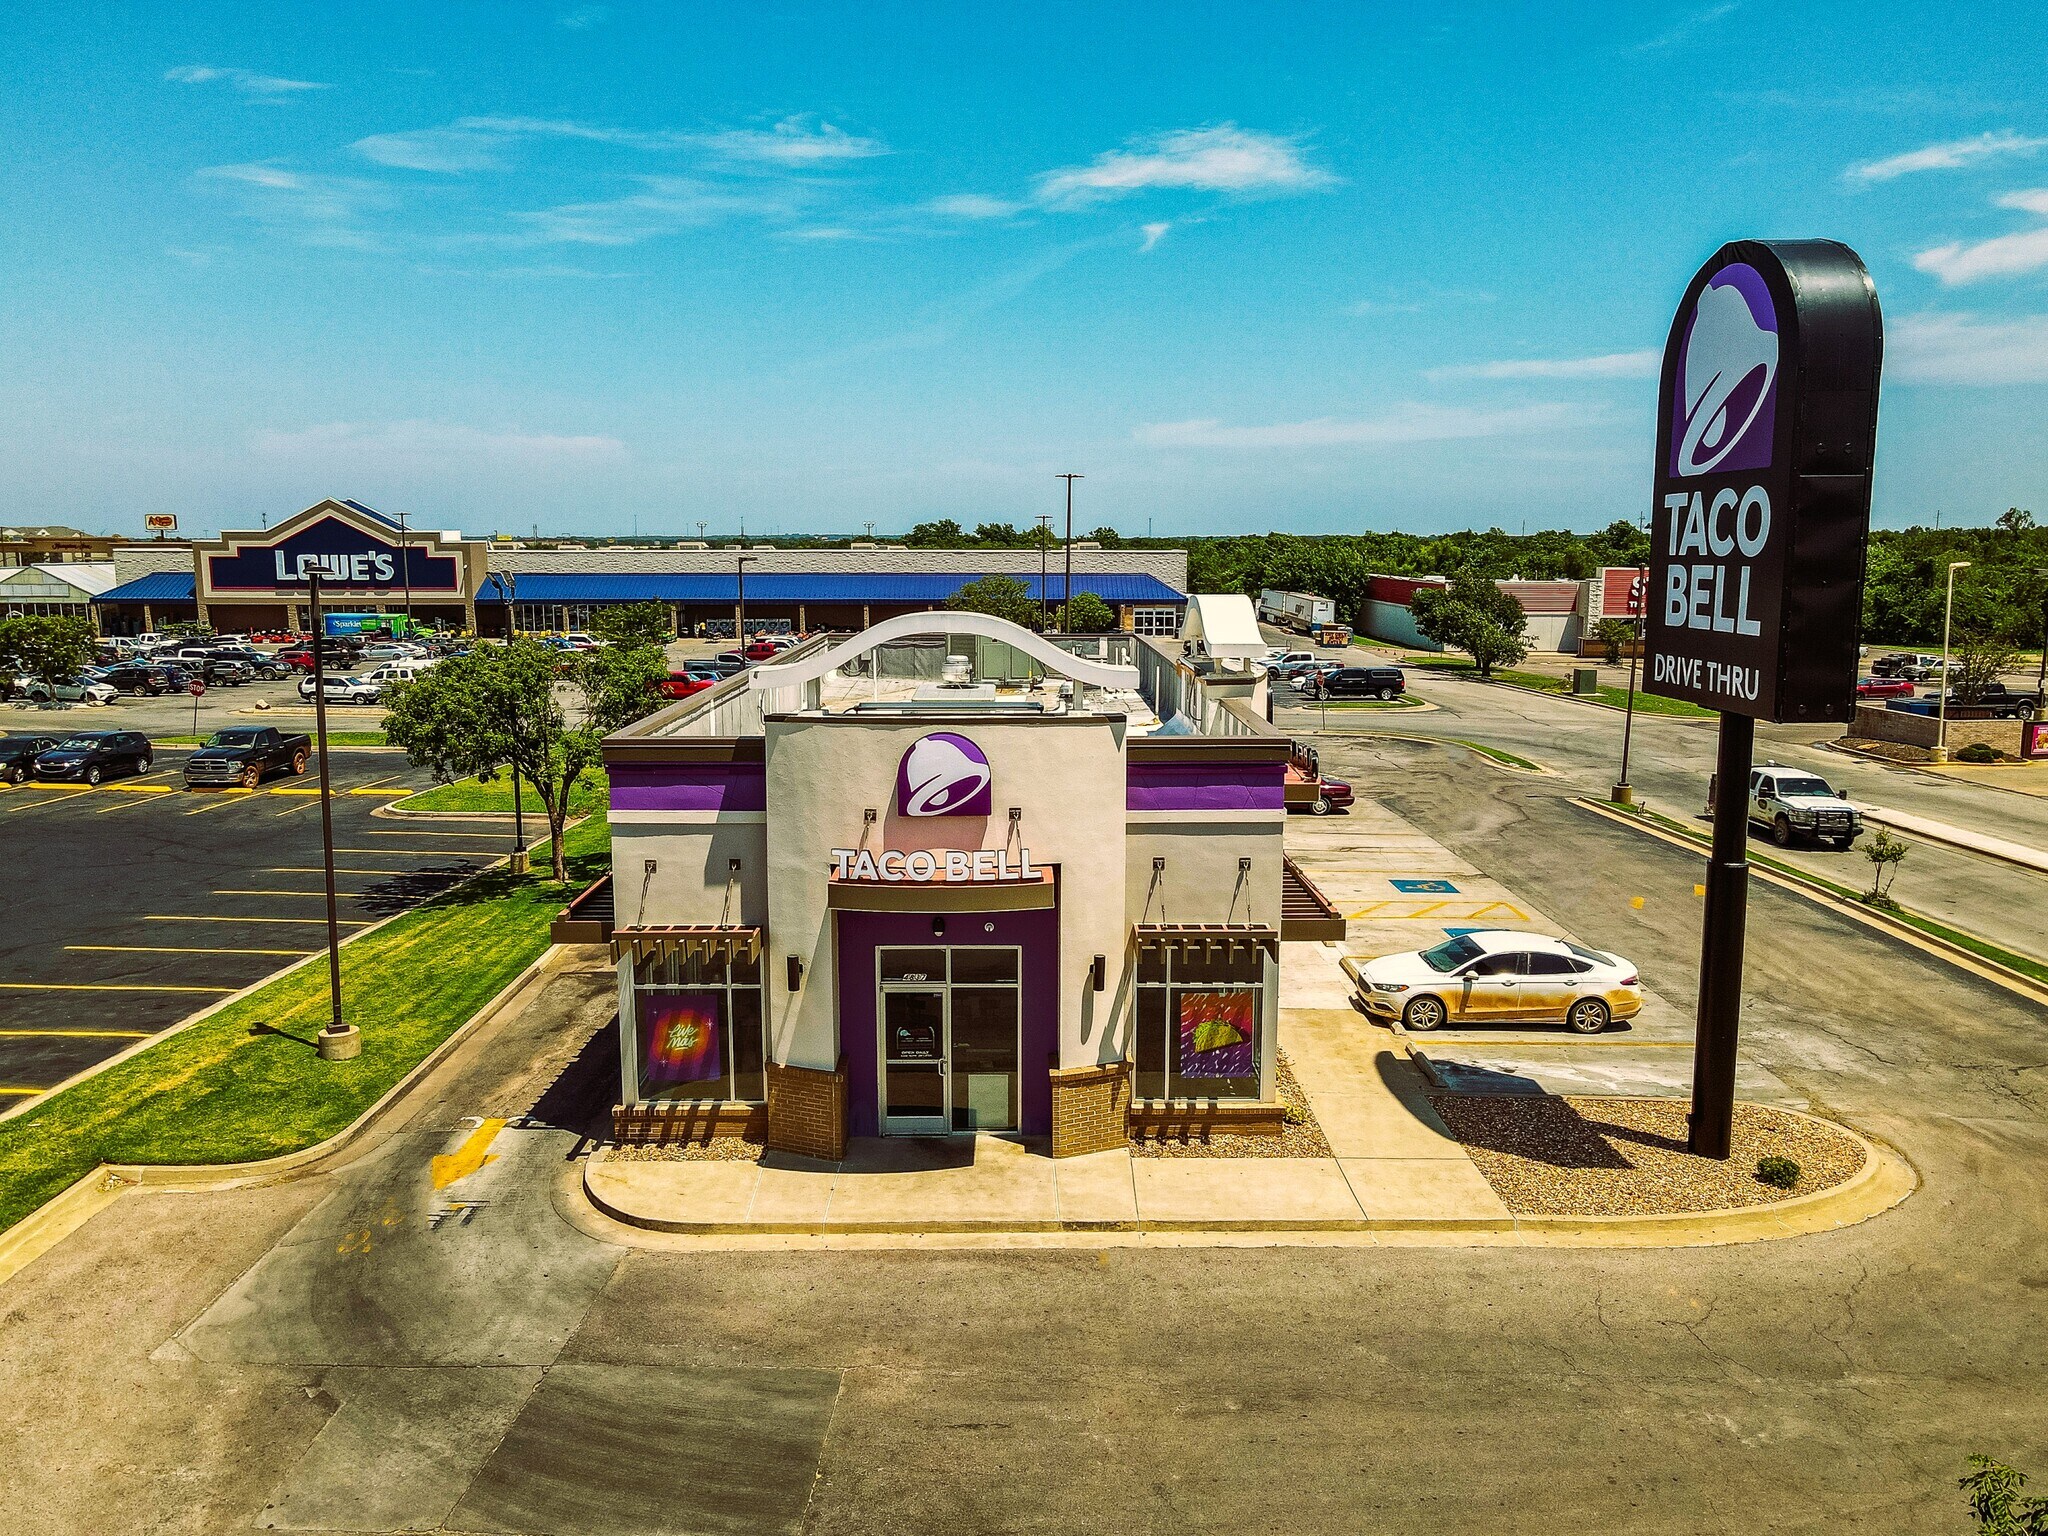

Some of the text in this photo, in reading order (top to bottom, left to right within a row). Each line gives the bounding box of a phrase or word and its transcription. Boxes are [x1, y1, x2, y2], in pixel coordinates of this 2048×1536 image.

[1664, 485, 1771, 557] TACO
[275, 550, 395, 580] LOWE'S
[1665, 564, 1761, 637] BELL
[190, 684, 205, 692] STOP
[1654, 653, 1760, 701] DRIVE THRU
[831, 848, 1043, 882] TACO BELL
[668, 1023, 699, 1038] Live
